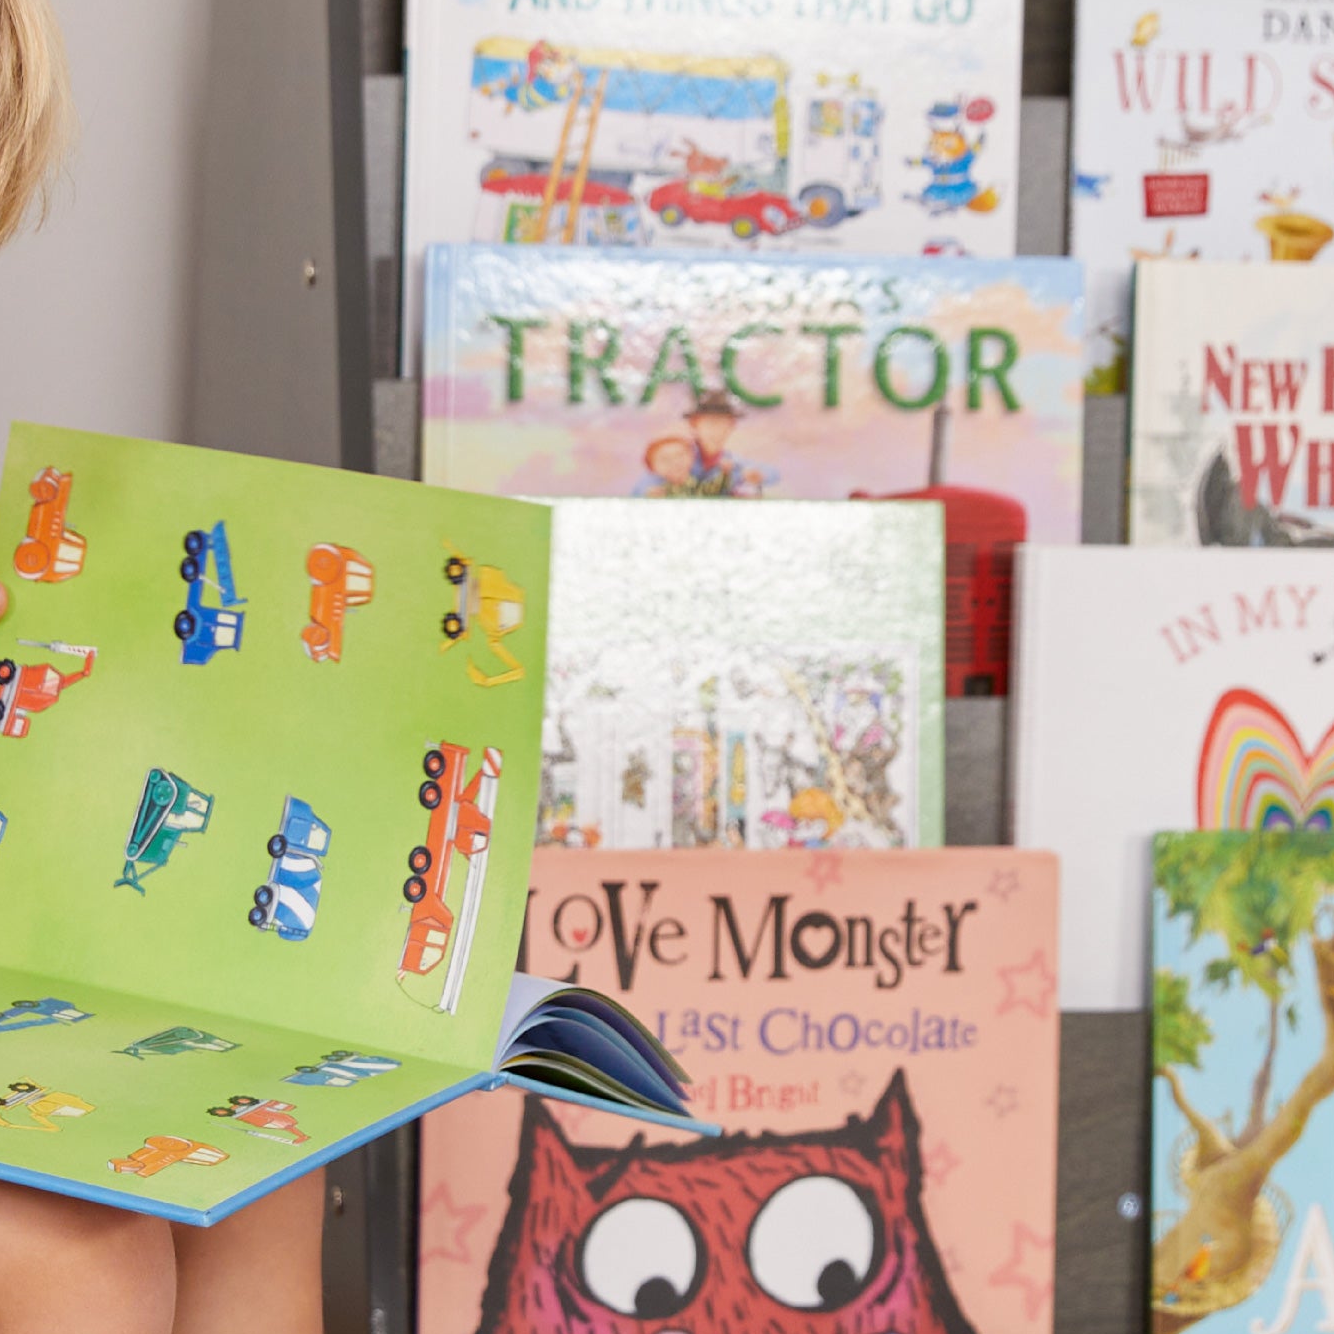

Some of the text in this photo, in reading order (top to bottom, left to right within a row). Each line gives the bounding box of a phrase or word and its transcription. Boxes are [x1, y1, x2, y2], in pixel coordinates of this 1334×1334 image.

[1114, 50, 1282, 119] WILD
[493, 313, 1021, 412] TRACTOR
[1201, 343, 1308, 413] NEW
[1159, 603, 1221, 663] IN
[1233, 584, 1318, 634] MY
[708, 894, 979, 990] Monster
[656, 1007, 979, 1056] Last Chocolate
[727, 1073, 821, 1112] Bright
